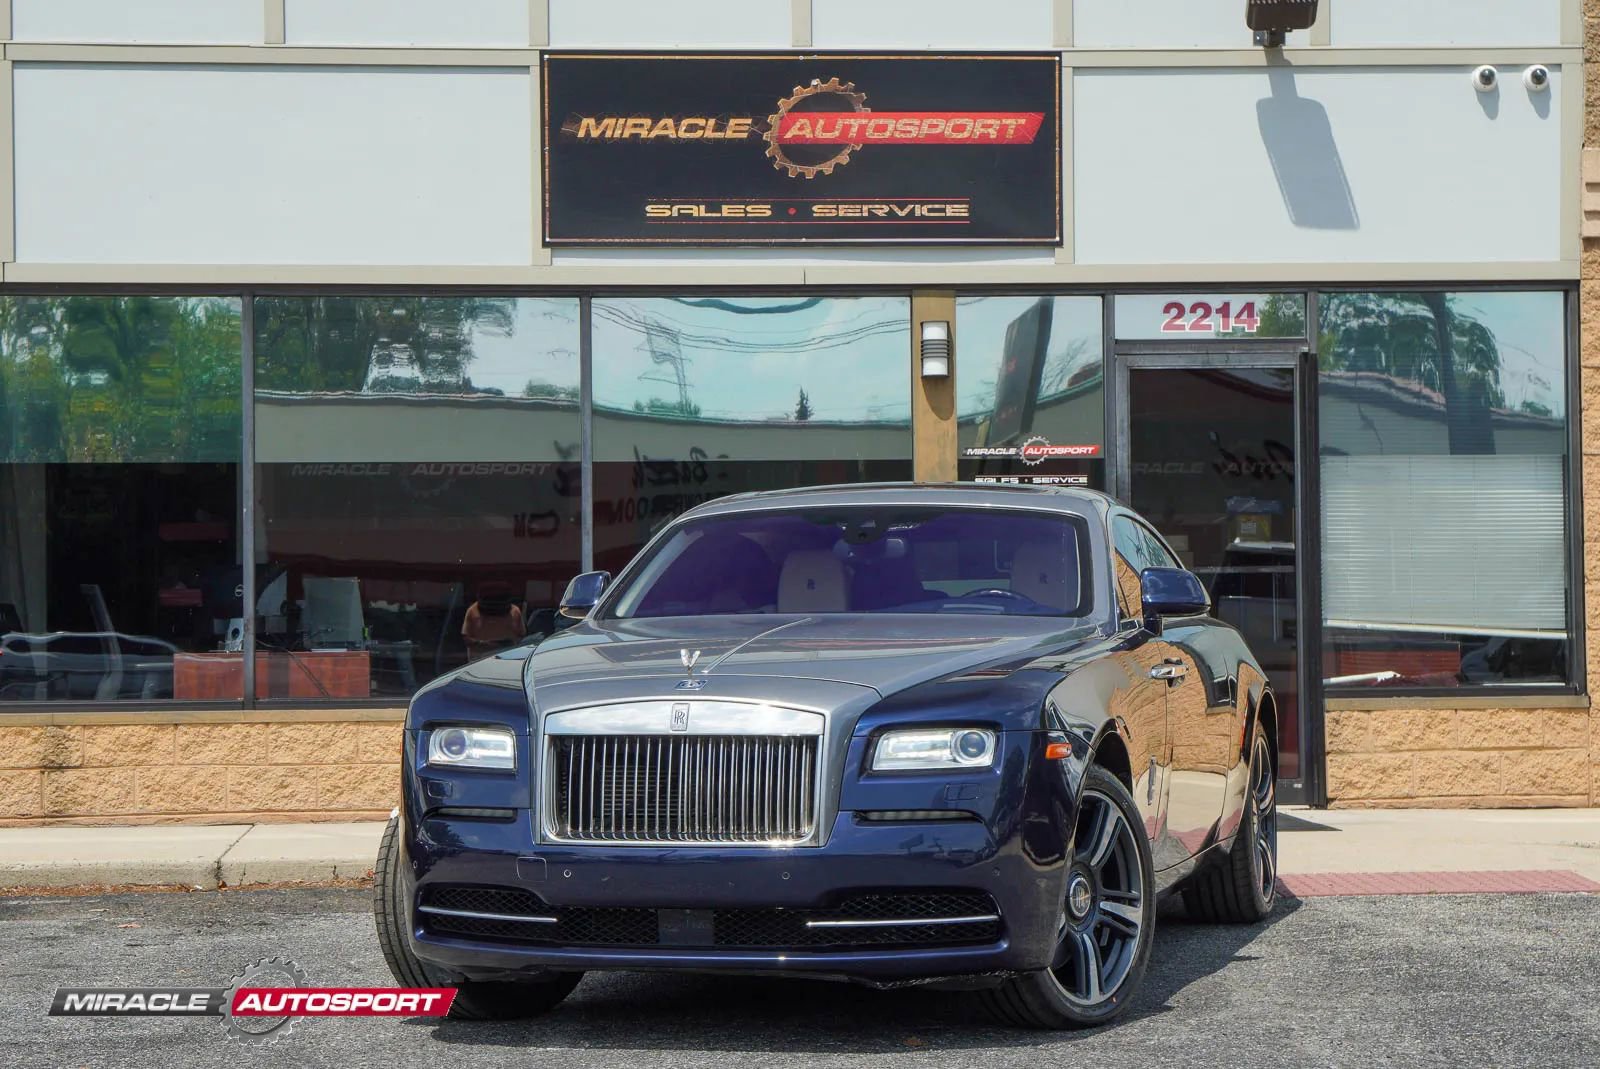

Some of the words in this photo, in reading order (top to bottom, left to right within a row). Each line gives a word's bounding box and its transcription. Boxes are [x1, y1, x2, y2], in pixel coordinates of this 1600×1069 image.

[576, 117, 753, 140] MIRACLE
[783, 117, 1026, 140] AUTOSPORT
[645, 204, 772, 217] SALES
[812, 204, 970, 217] SERVICE
[1161, 301, 1260, 333] 2214
[966, 447, 1017, 456] MIRACLE
[1025, 446, 1095, 455] AUTOSPORT
[291, 464, 392, 476] MIRACLE
[410, 464, 552, 476] AUTOSPORT
[1032, 476, 1088, 484] SERVICE
